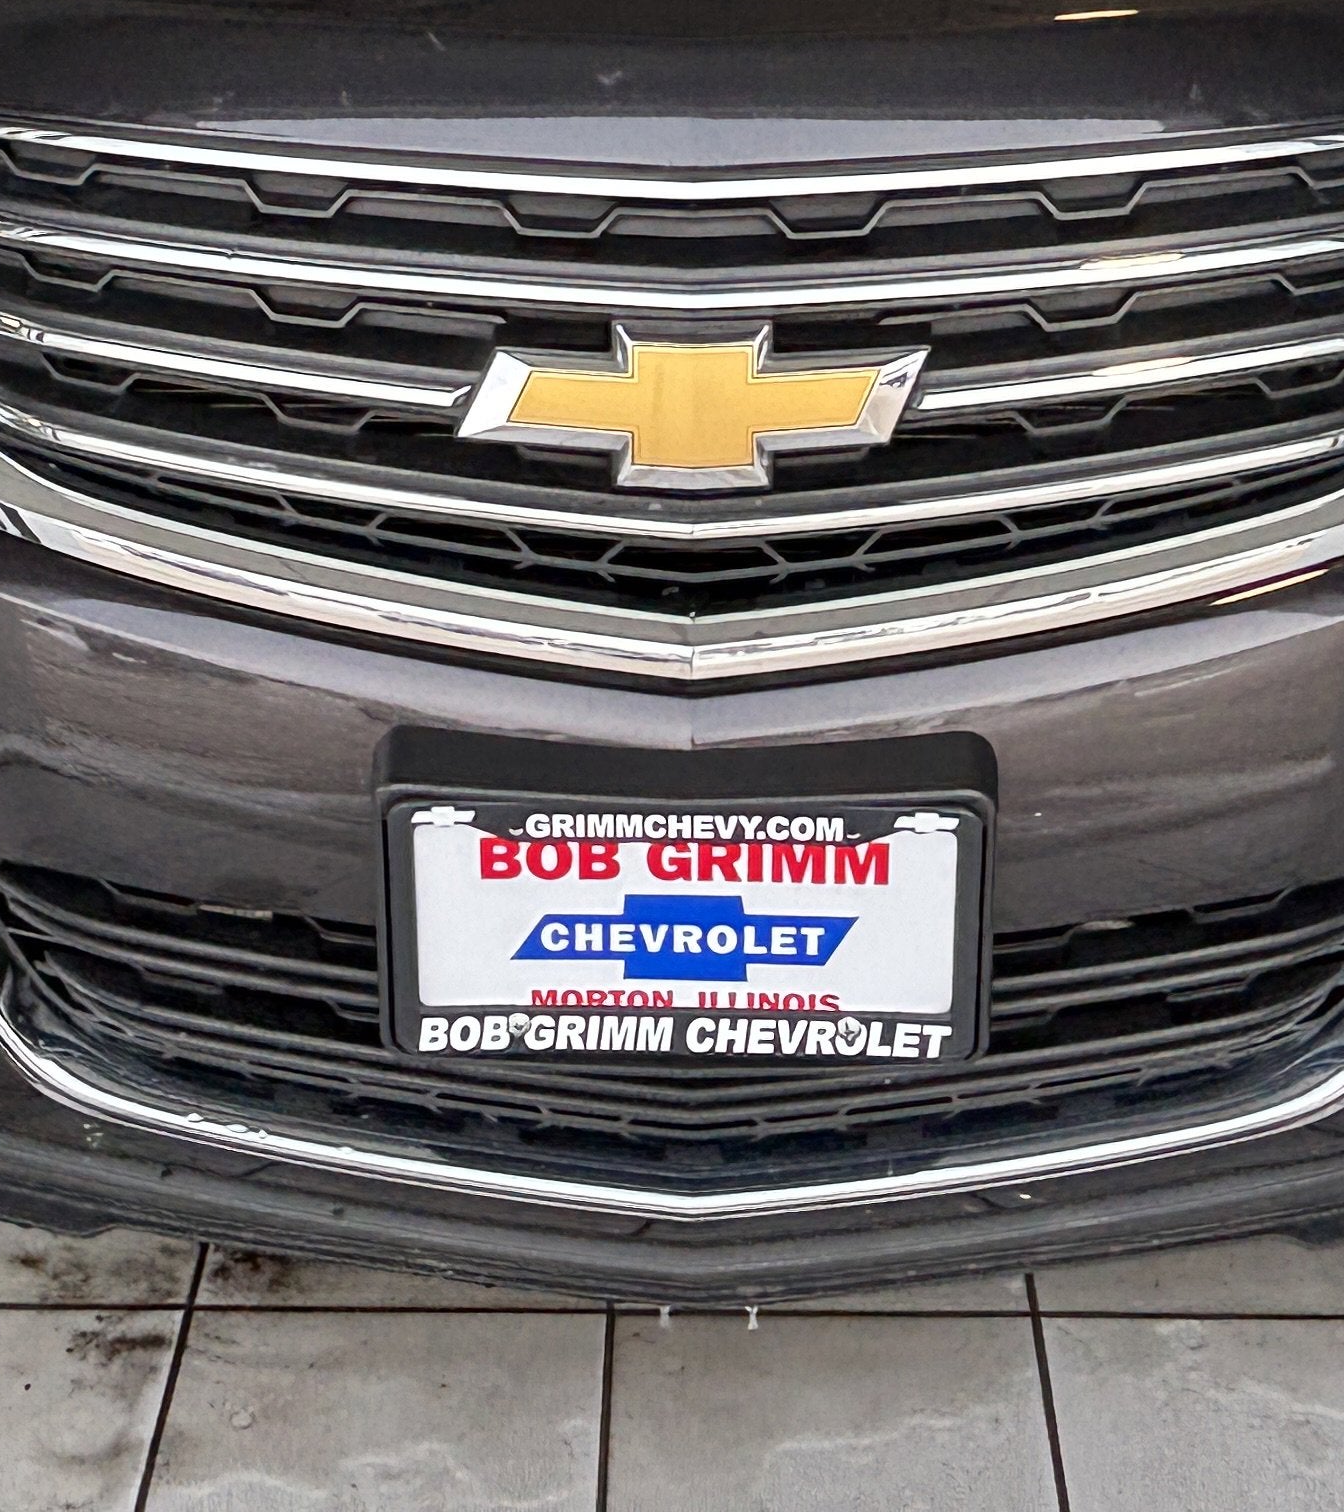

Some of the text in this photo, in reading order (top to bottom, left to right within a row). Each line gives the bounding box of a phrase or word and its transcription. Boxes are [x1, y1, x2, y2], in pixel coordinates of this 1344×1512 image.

[525, 813, 844, 841] GRIMMCHEVY.COM
[480, 838, 890, 886] BOB GRIMM
[540, 922, 825, 956] CHEVROLET
[419, 1015, 952, 1059] BOB GRIMM CHEVROLET
